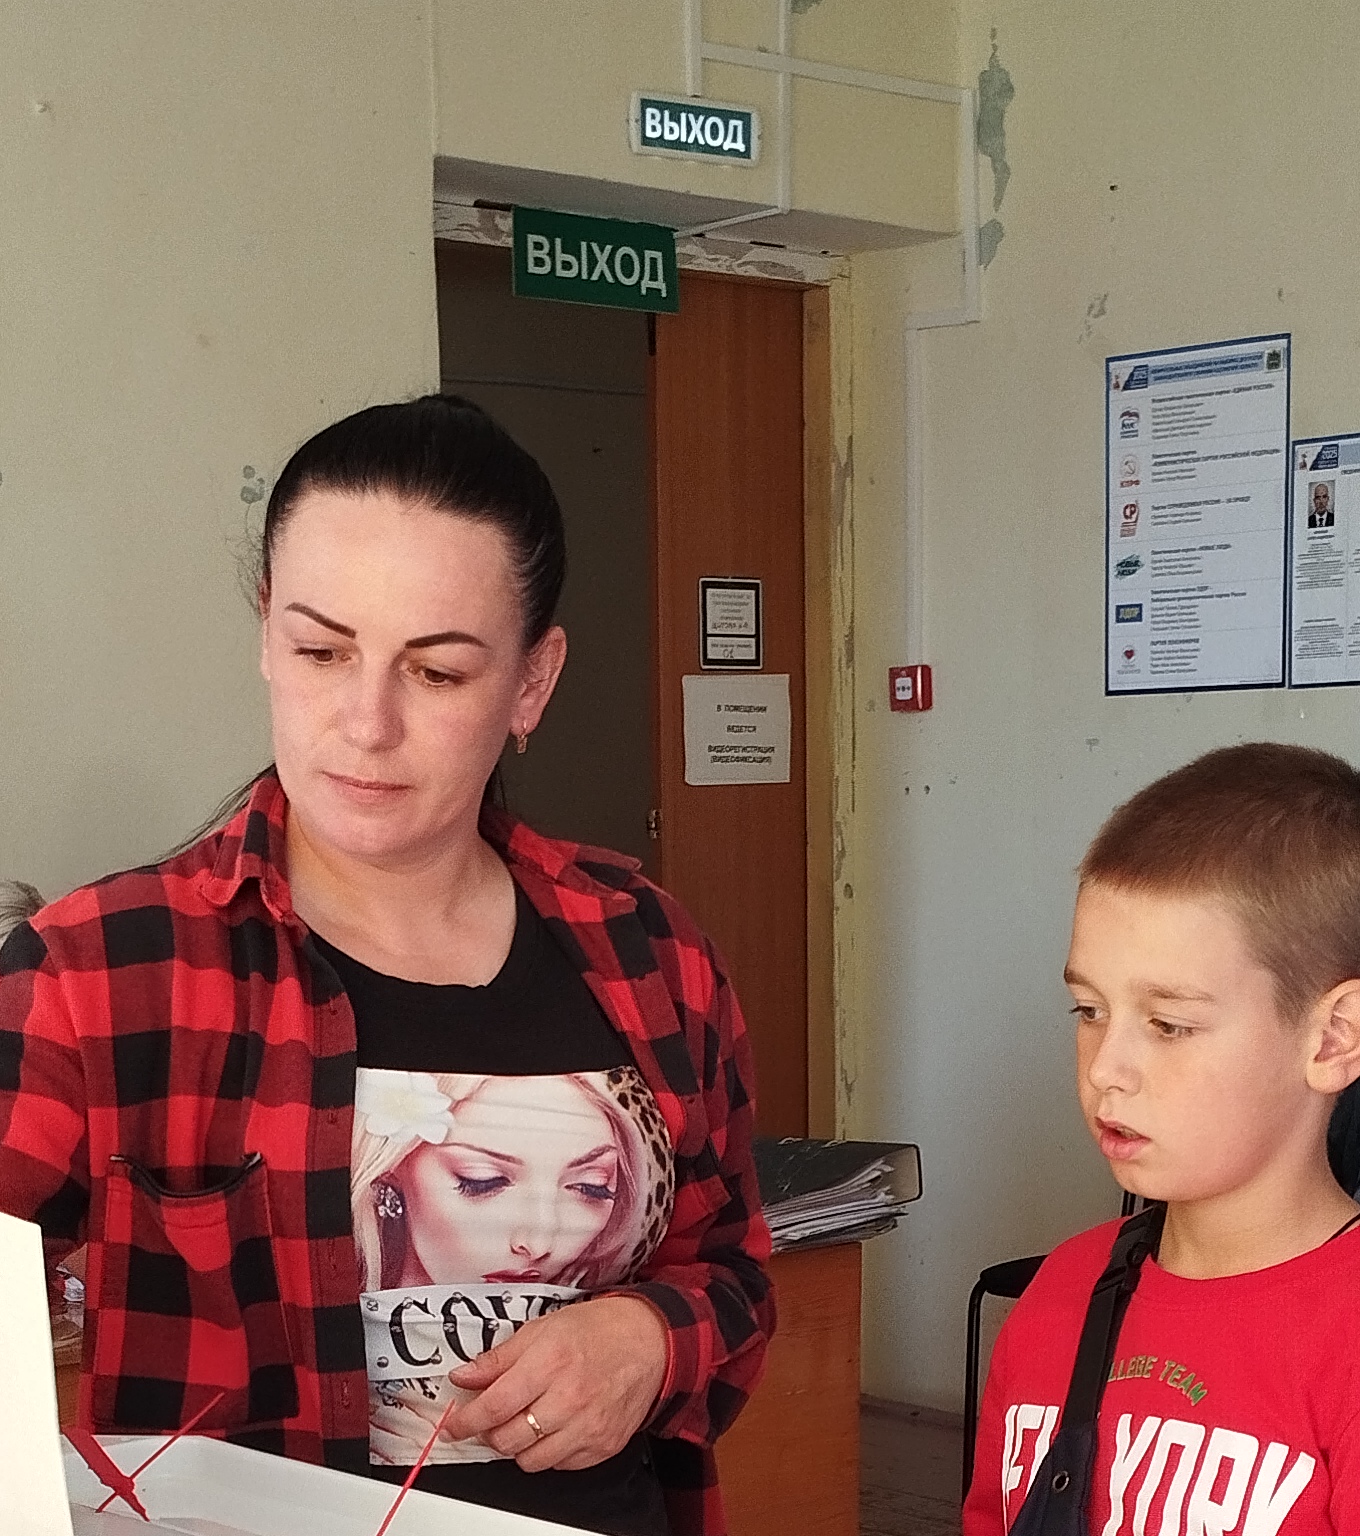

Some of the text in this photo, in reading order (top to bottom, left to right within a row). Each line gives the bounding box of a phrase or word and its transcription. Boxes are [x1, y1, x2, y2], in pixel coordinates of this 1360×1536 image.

[644, 107, 746, 153] ВЫХОД
[526, 233, 667, 298] ВЫХОД
[390, 1292, 577, 1367] COV
[1107, 1354, 1208, 1407] LLEGE TEAM
